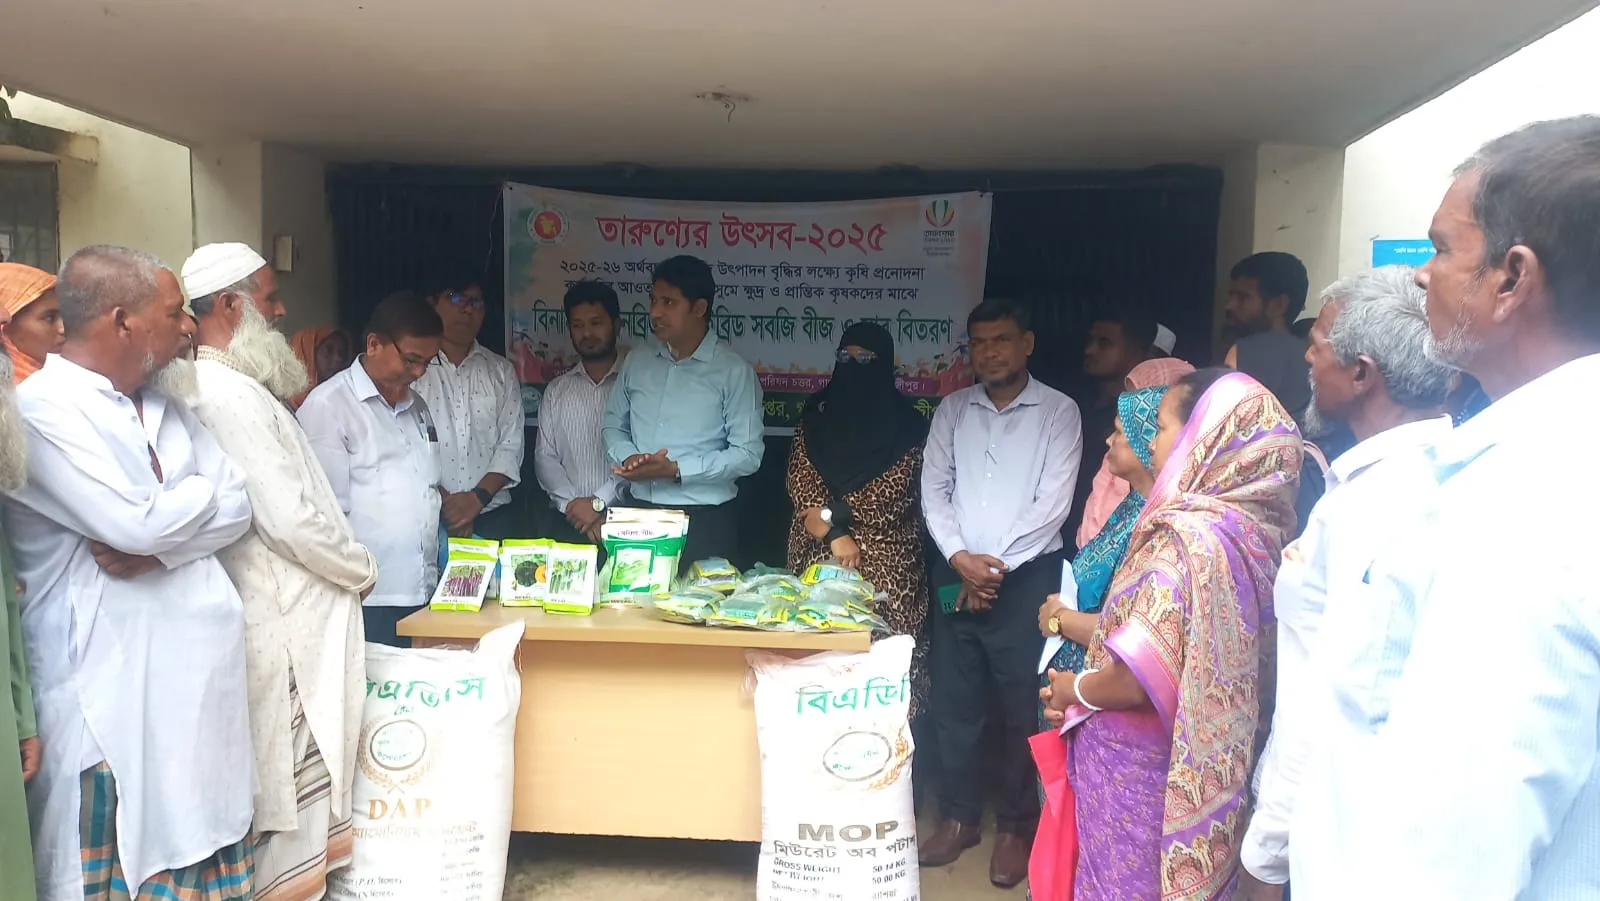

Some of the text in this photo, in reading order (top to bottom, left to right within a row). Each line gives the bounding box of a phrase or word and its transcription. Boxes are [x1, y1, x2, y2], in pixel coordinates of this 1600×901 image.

[595, 214, 711, 249] তারুণ্যের
[719, 212, 888, 255] উৎসব-২০২৫
[560, 260, 620, 275] ২০২৫-২৬
[624, 259, 655, 274] অর্থব
[717, 260, 767, 278] উৎপাদন
[771, 261, 802, 282] বৃদ্ধির
[807, 265, 841, 280] লক্ষ্যে
[844, 264, 869, 284] কৃষি
[618, 281, 653, 295] আওত
[742, 285, 768, 301] ক্ষুদ্র
[770, 286, 780, 297] ও
[784, 282, 824, 300] প্রান্তিক
[829, 286, 883, 303] কৃষকদের
[887, 286, 919, 300] মাঝে
[750, 306, 797, 345] সবজি
[801, 306, 835, 343] বীজ
[896, 308, 953, 344] বিতরণ
[368, 797, 433, 820] DAP
[798, 820, 899, 842] MOP
[772, 840, 837, 858] মিউরেট
[846, 846, 878, 858] অব
[773, 856, 802, 871] GROSS
